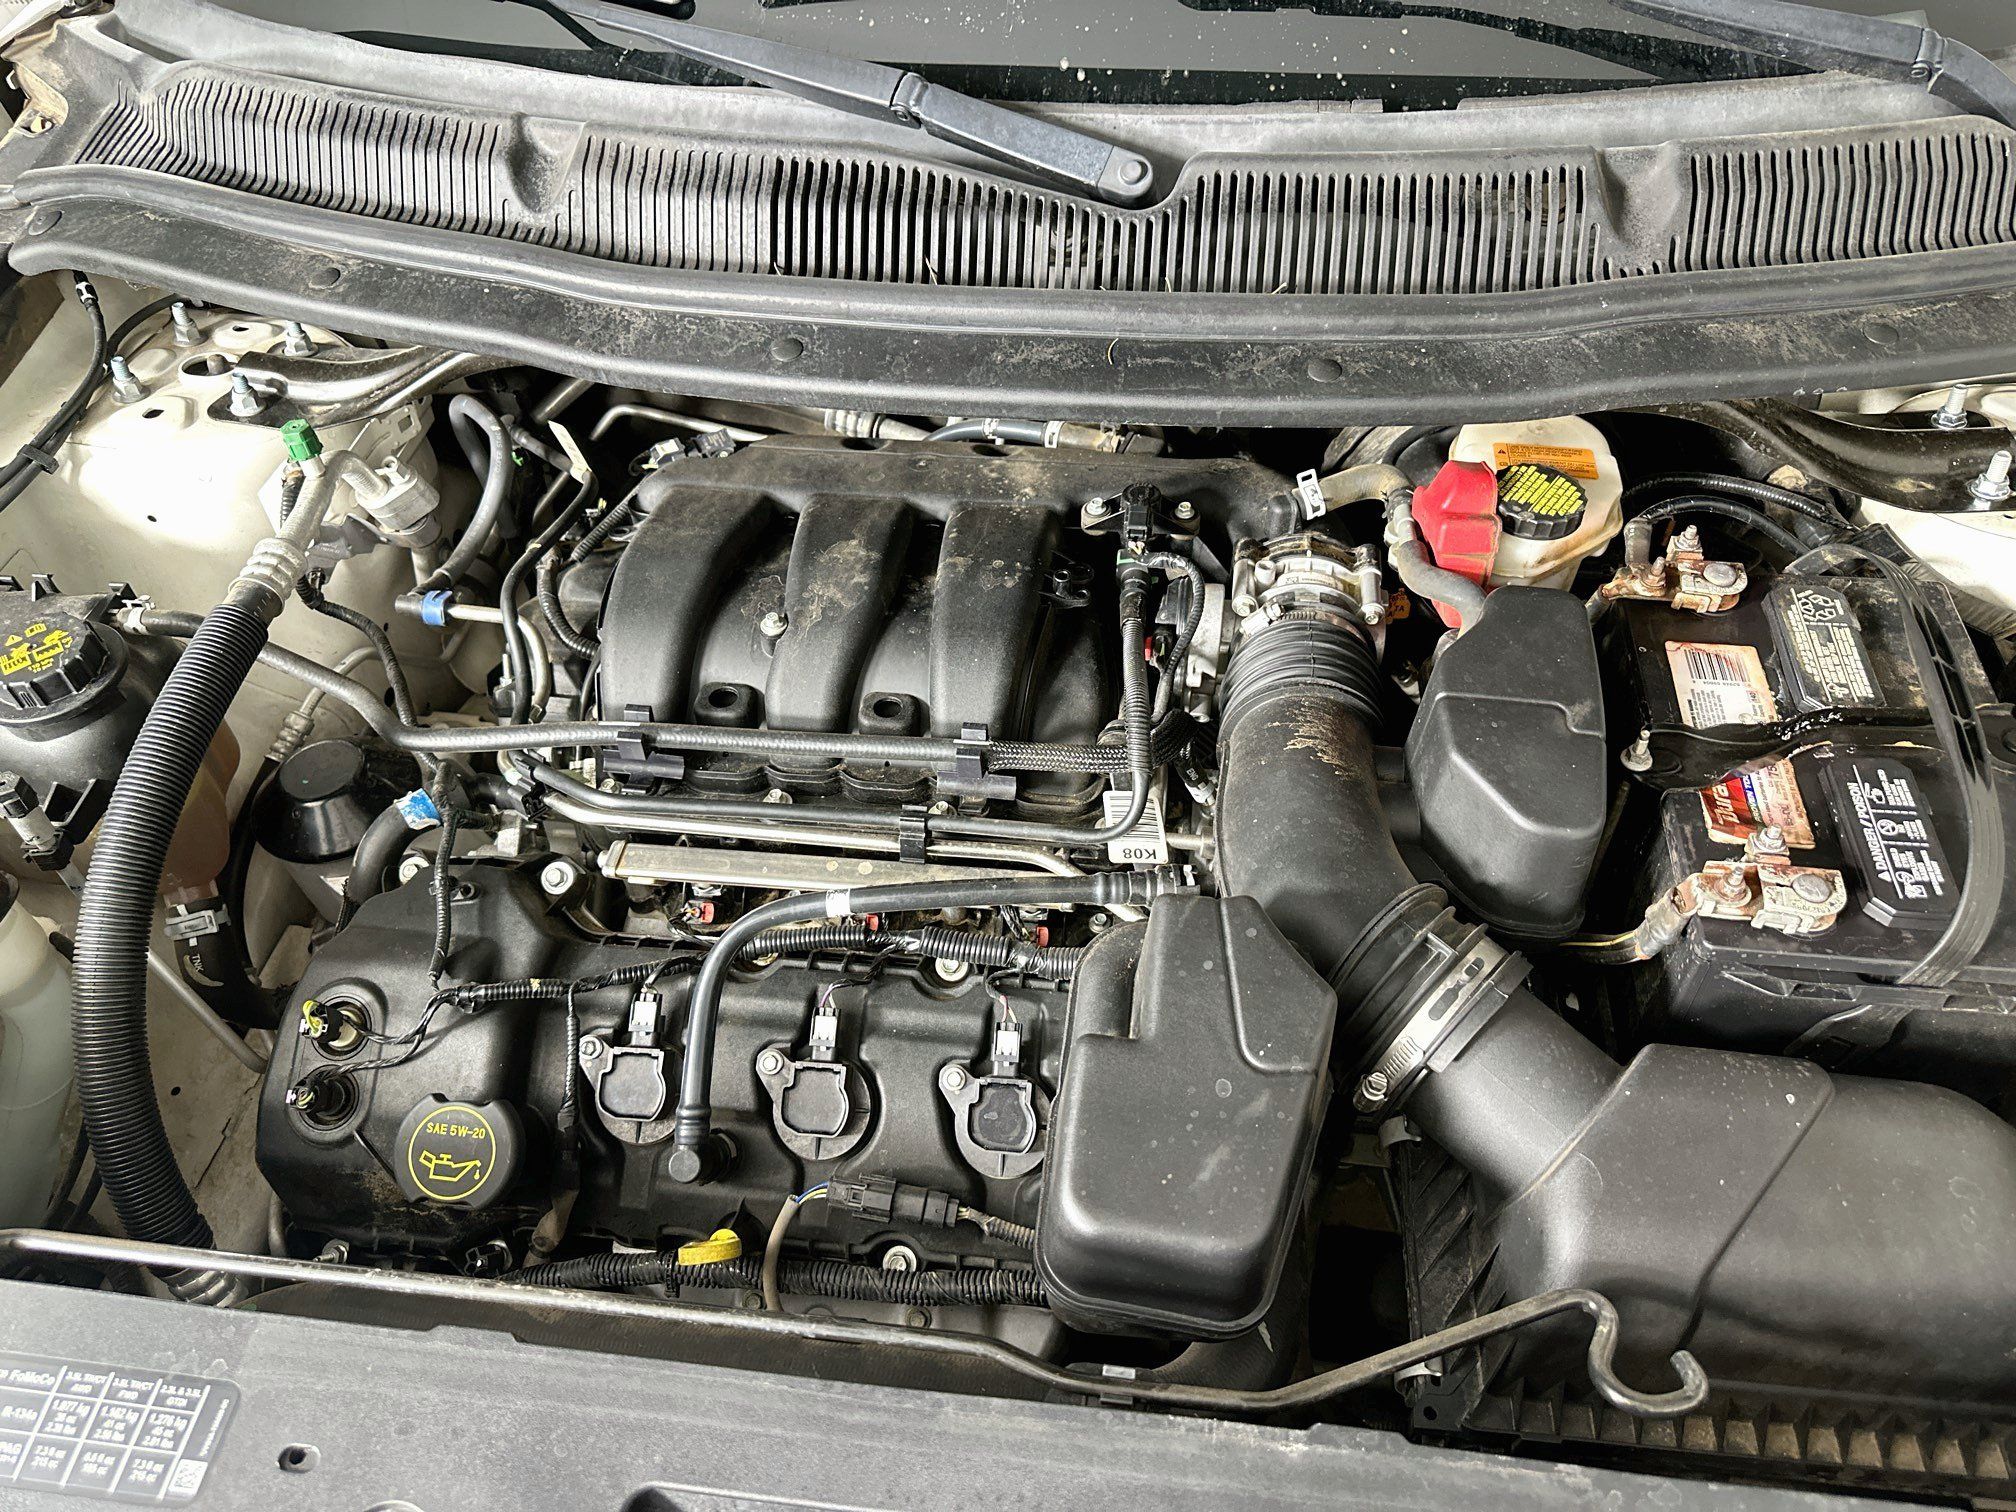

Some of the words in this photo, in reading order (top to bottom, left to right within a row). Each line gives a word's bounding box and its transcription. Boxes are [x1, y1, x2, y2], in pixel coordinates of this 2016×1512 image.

[1123, 848, 1157, 860] K08
[191, 953, 203, 972] TNK
[427, 1122, 447, 1135] SAE
[450, 1124, 486, 1140] 5W-20
[8, 1369, 57, 1385] FoMoCo
